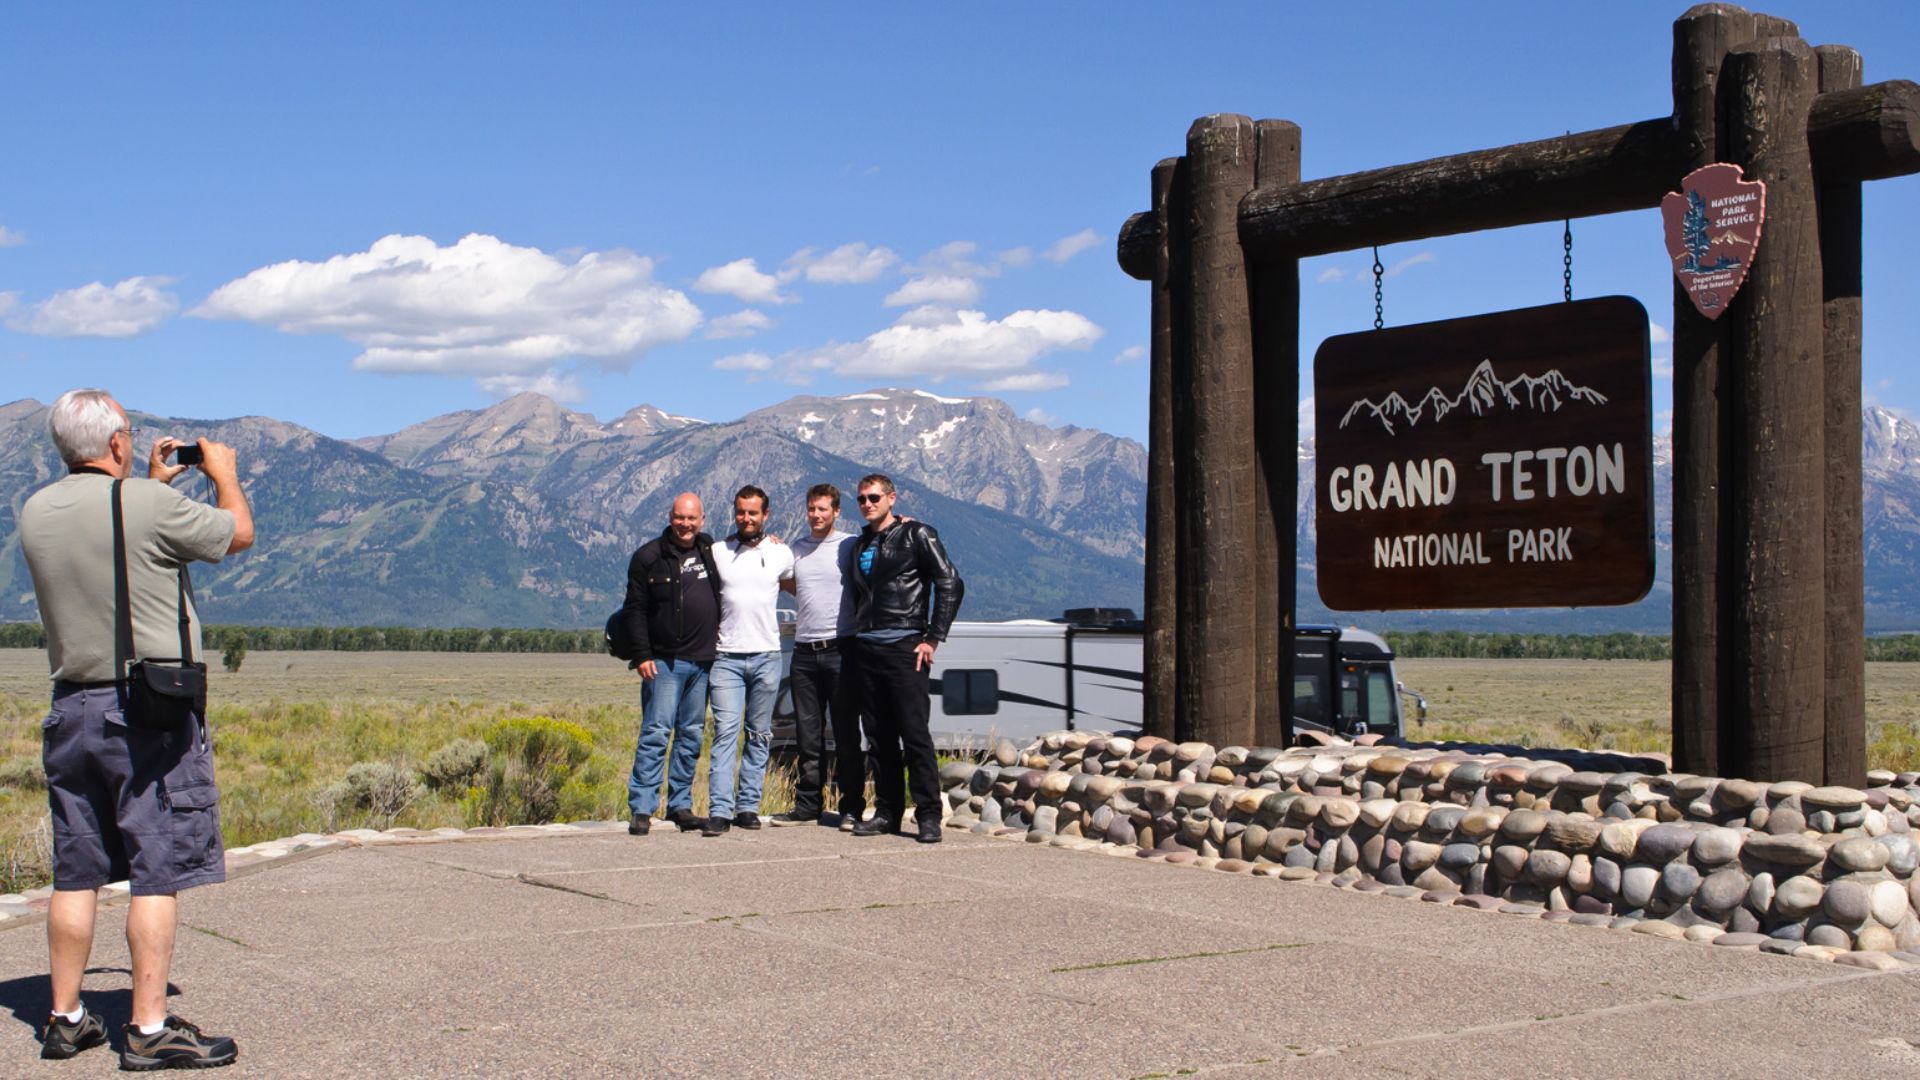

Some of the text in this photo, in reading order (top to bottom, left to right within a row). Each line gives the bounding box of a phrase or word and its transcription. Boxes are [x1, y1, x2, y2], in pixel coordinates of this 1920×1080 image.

[1711, 192, 1757, 208] NATIONAL
[1722, 204, 1746, 216] PARK
[1715, 213, 1754, 228] SERVICE
[1692, 272, 1731, 285] Department
[1329, 442, 1625, 512] GRAND TETON
[1374, 526, 1573, 568] NATIONAL PARK
